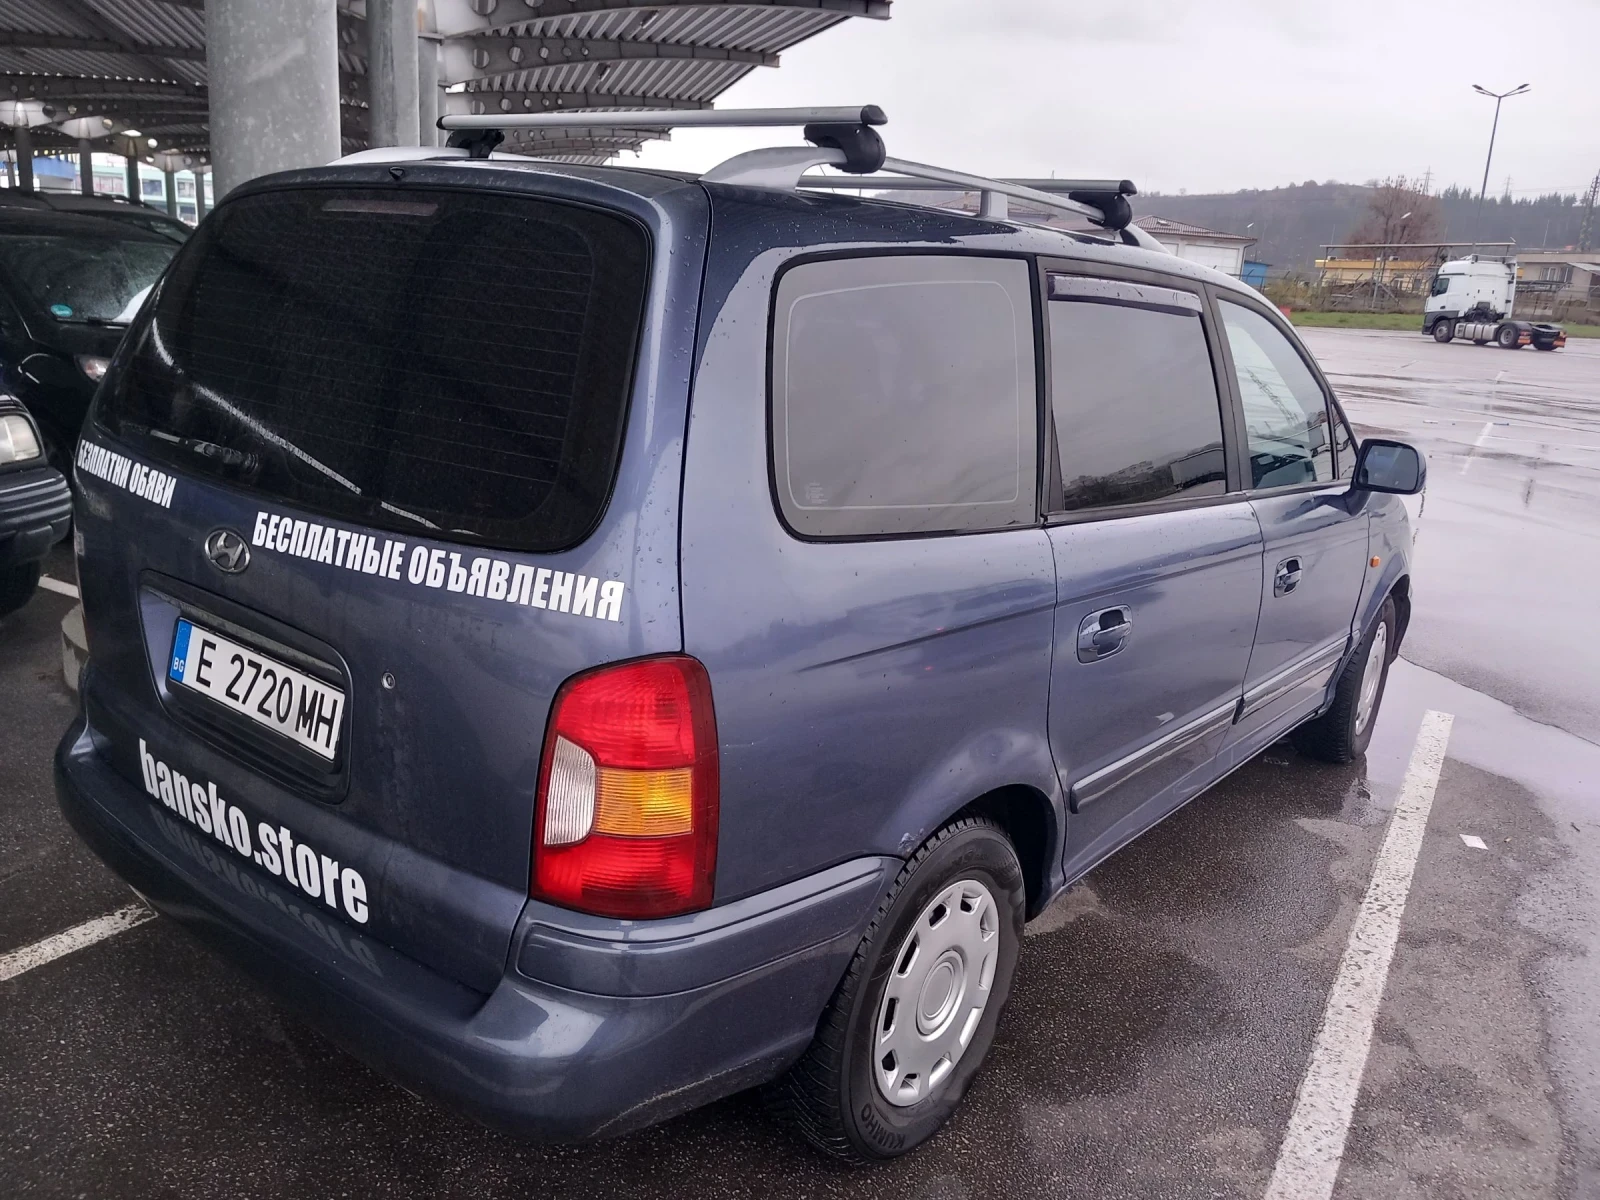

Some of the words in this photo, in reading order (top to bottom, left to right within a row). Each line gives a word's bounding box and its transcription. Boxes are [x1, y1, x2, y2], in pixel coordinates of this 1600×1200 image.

[77, 439, 132, 489] БЕЗПЛАТНИ
[129, 462, 177, 509] ОБЯВИ
[252, 511, 406, 581] БЕСПЛАТНЫЕ
[407, 545, 625, 622] ОБЪЯВЛЕНИЯ
[173, 657, 186, 672] BG
[196, 638, 217, 688] E
[225, 653, 293, 724] 2720
[295, 684, 338, 749] MH
[139, 737, 369, 924] bansko.store
[860, 1103, 906, 1149] KUMHO
